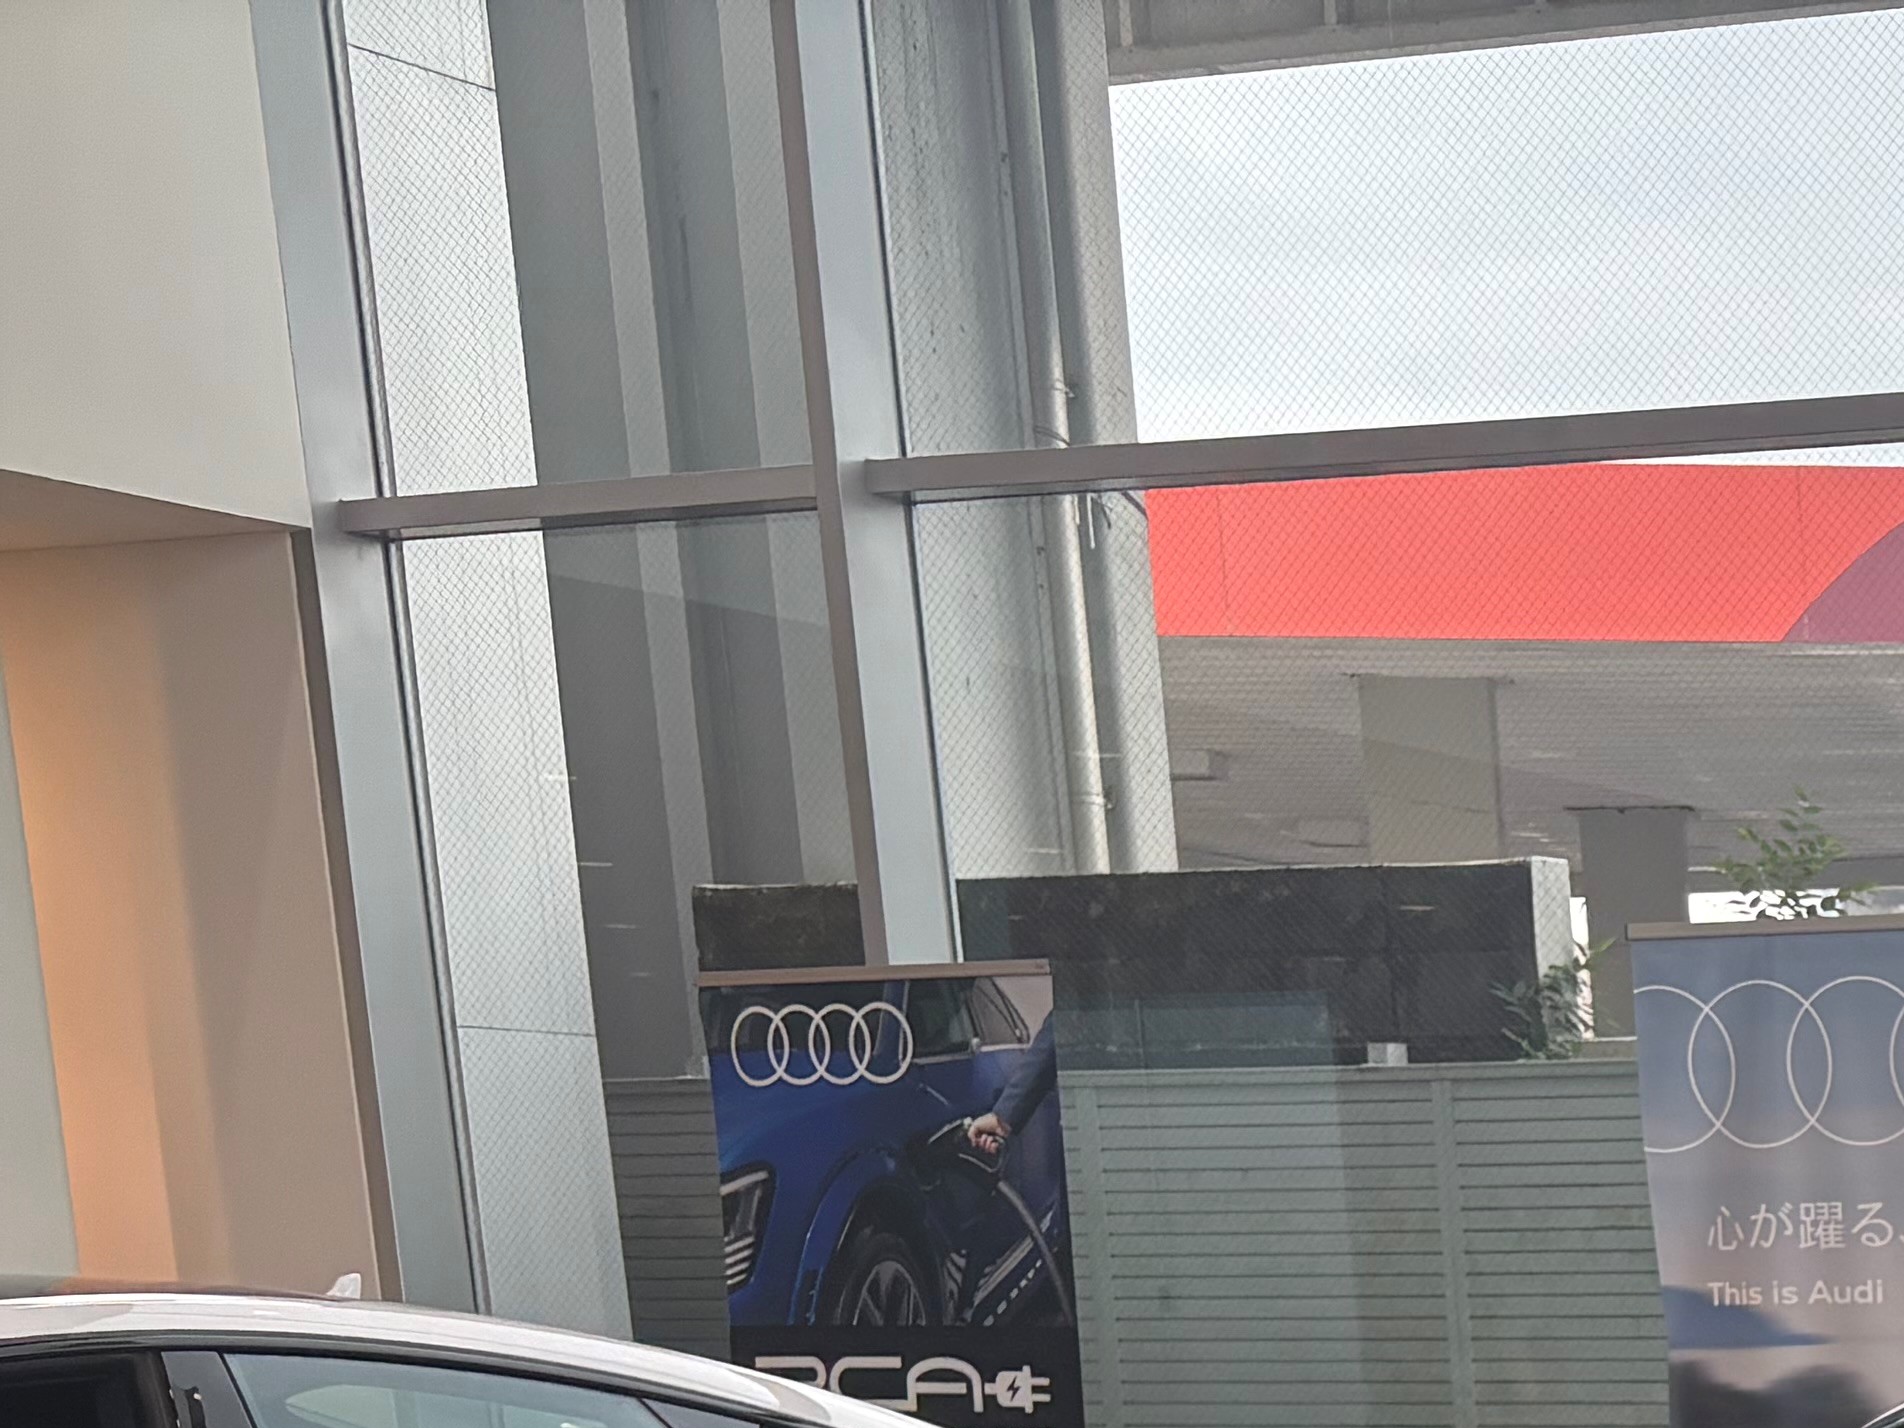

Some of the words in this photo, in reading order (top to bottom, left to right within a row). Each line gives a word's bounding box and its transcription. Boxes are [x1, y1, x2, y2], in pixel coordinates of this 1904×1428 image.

[1706, 1280, 1763, 1307] This
[1771, 1280, 1799, 1305] is
[1807, 1278, 1884, 1305] Audi
